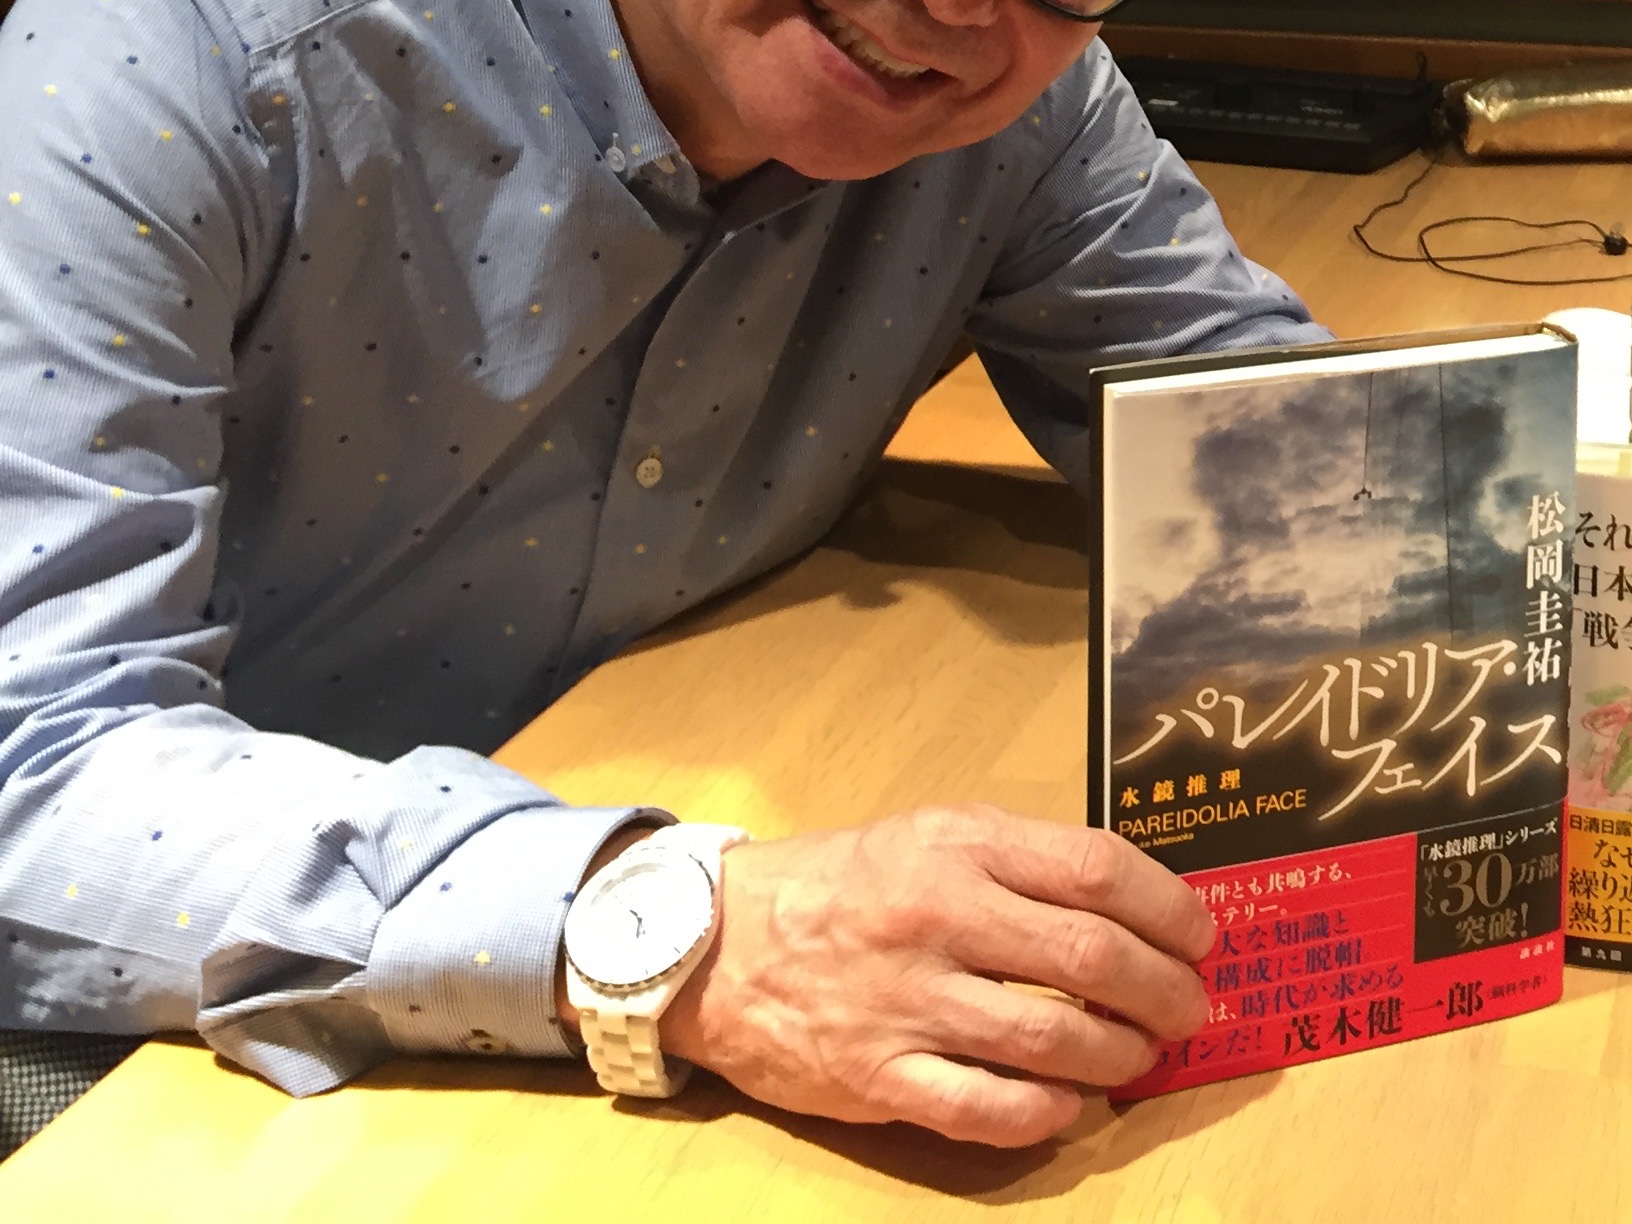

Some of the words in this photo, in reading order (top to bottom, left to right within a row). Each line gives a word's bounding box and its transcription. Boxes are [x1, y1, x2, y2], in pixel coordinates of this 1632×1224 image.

[1522, 491, 1566, 686] 松岡圭祐
[1119, 768, 1242, 809] 水鏡推理
[1317, 715, 1563, 822] フェイス
[1118, 799, 1251, 839] PAREIDOLIA
[1255, 788, 1308, 816] FACE
[1420, 817, 1559, 862] 「水鏡推理」シリーズ
[1281, 978, 1484, 1059] 茂木健一郎
